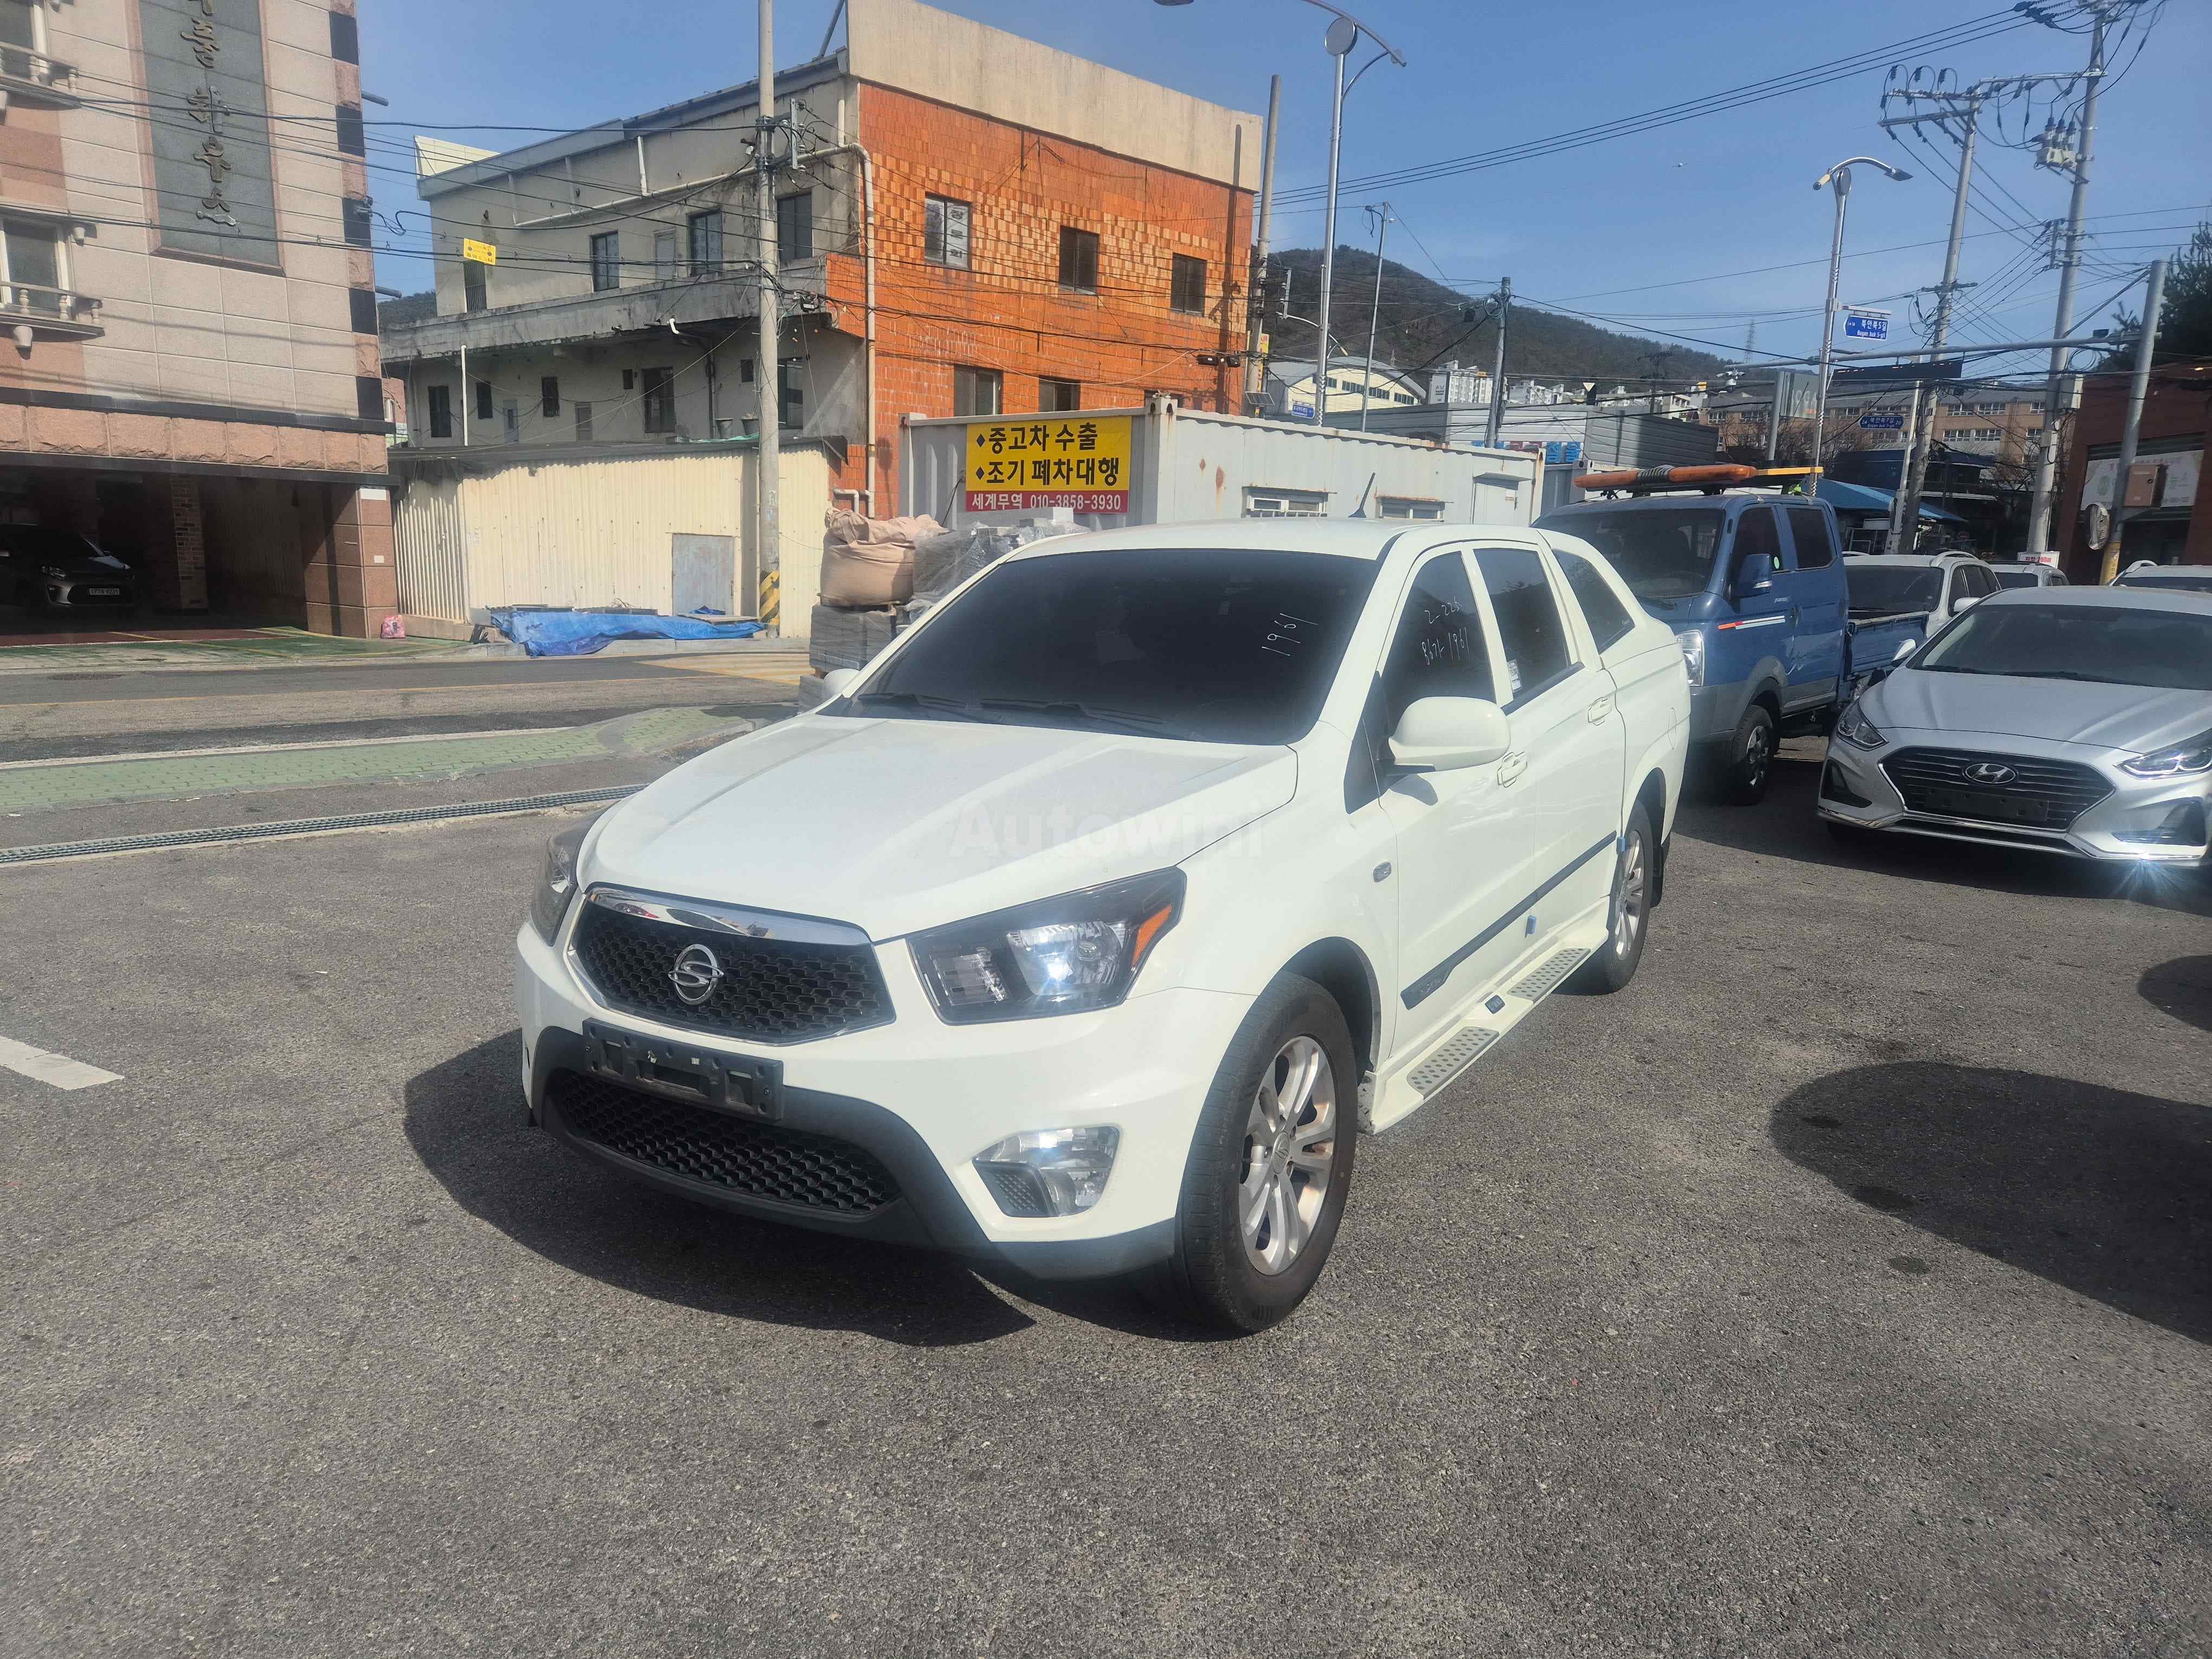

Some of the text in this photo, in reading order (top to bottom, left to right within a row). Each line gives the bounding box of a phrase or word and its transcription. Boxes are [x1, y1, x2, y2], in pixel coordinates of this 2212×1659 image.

[1861, 319, 1887, 331] 북안북5길
[988, 422, 1098, 454] 중고차 수출
[986, 457, 1120, 486] 조기 폐차대행
[972, 493, 1121, 510] 세계무역 010-3858-3930
[1261, 612, 1319, 657] 1961
